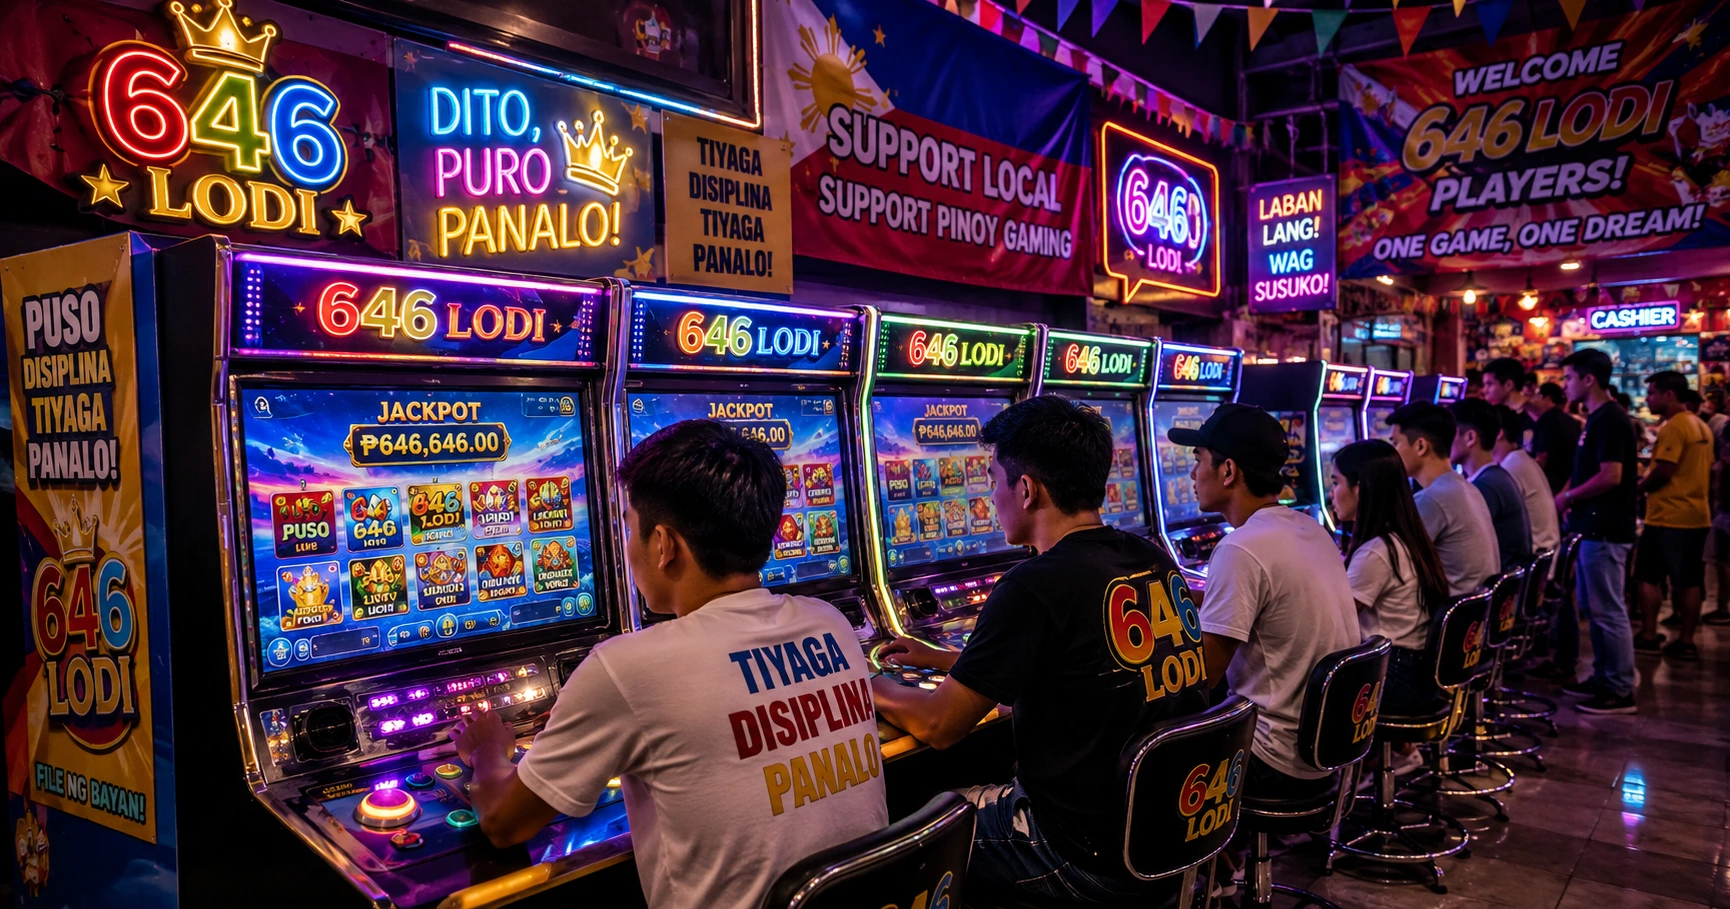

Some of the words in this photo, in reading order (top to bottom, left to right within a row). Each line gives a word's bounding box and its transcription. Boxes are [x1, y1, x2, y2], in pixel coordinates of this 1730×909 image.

[1454, 42, 1622, 96] WELCOME
[102, 50, 345, 187] 646
[430, 87, 541, 142] DITO,
[1403, 99, 1526, 172] 646
[1526, 80, 1674, 154] LODI
[436, 147, 551, 198] PURO
[697, 136, 763, 177] TIYAGA
[828, 103, 977, 192] SUPPORT
[983, 153, 1062, 213] LOCAL
[147, 166, 320, 236] LODI
[689, 171, 773, 212] DISIPLINA
[1259, 188, 1323, 221] LABAN
[1430, 154, 1630, 211] PLAYERS!
[437, 202, 622, 258] PANALO!
[700, 208, 765, 243] TIYAGA
[819, 174, 932, 234] SUPPORT
[936, 207, 999, 246] PINOY
[1003, 219, 1073, 259] GAMING
[1263, 215, 1321, 246] LANG!
[1373, 234, 1427, 262] ONE
[1430, 225, 1513, 257] GAME,
[1519, 218, 1578, 248] ONE
[1585, 204, 1708, 243] DREAM!
[693, 243, 773, 278] PANALO!
[1148, 243, 1183, 275] LODI
[1269, 248, 1314, 275] WAG
[1254, 272, 1330, 302] SUSUKO!
[25, 289, 100, 350] PUSO
[317, 281, 438, 341] 646
[445, 302, 547, 343] LODI
[677, 311, 753, 357] 646
[756, 326, 822, 357] LODI
[1590, 306, 1676, 329] CASHIER
[23, 349, 112, 390] DISIPLINA
[909, 330, 959, 367] 646
[959, 342, 1006, 366] LODI
[1065, 343, 1102, 376] 646
[1101, 353, 1134, 375] LODI
[1174, 353, 1200, 381] 646
[1199, 362, 1223, 380] LODI
[31, 392, 107, 434] TIYAGA
[377, 400, 481, 423] JACKPOT
[707, 403, 773, 419] JACKPOT
[924, 404, 968, 417] JACKPOT
[28, 439, 118, 480] PANALO!
[281, 521, 330, 542] PUSO
[353, 519, 397, 540] 646
[36, 558, 134, 656] 646
[1108, 573, 1202, 665] 646
[46, 656, 135, 717] LODI
[728, 632, 850, 695] TIYAGA
[1140, 646, 1208, 703] LODI
[728, 677, 875, 760] DISIPLINA
[36, 764, 64, 794] FILE
[66, 774, 87, 801] NG
[90, 780, 145, 822] BAYAN!
[762, 732, 881, 817] PANALO
[1179, 748, 1245, 817] 646
[1184, 798, 1234, 843] LODI
